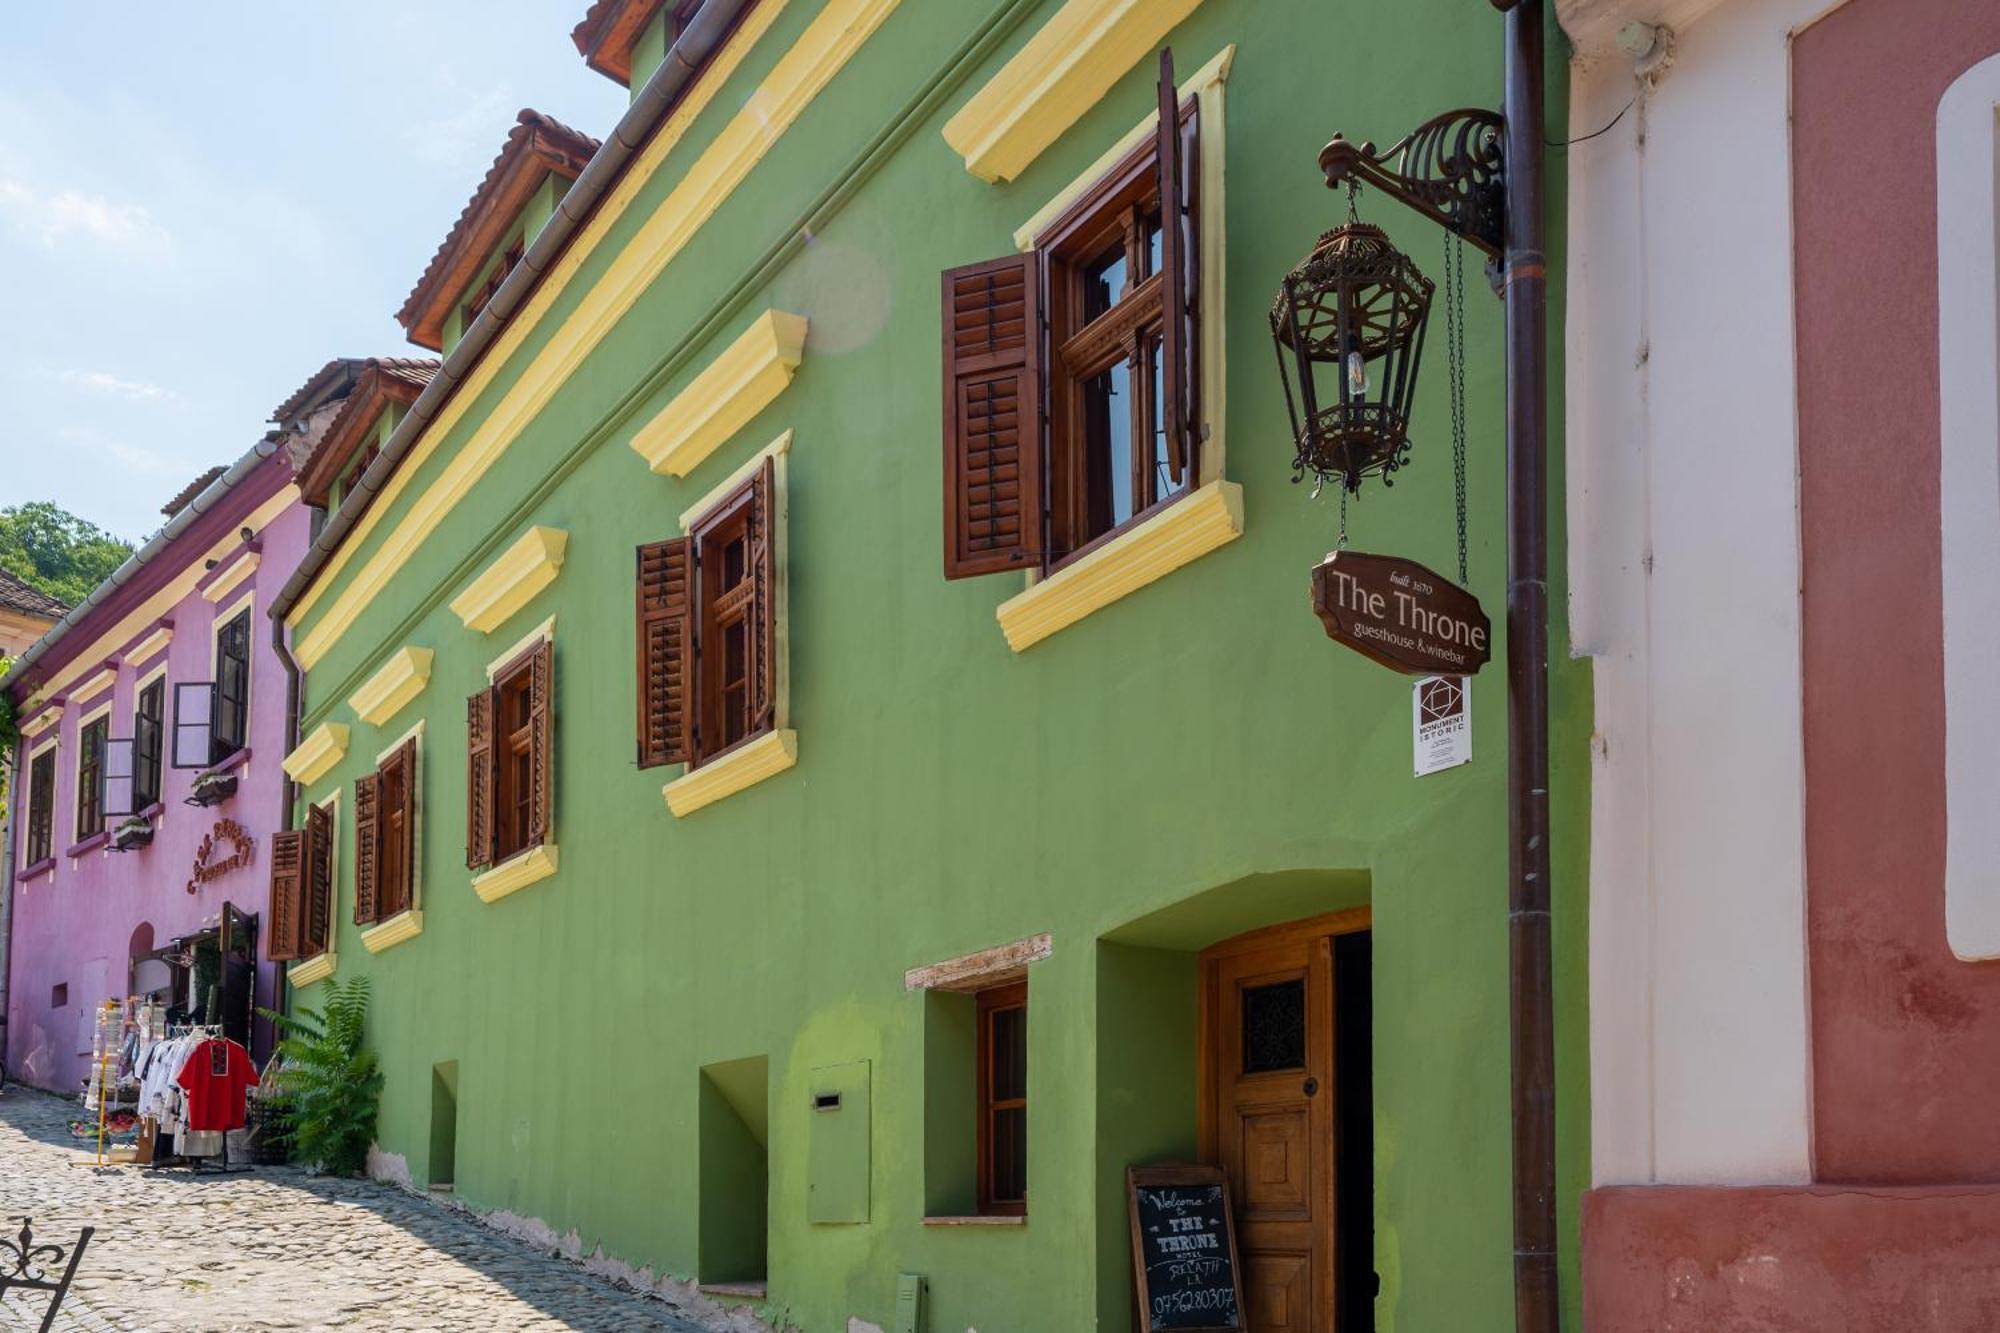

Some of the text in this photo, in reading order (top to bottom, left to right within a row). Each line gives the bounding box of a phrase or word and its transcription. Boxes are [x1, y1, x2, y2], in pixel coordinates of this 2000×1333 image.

[1333, 570, 1486, 651] The Throne
[1354, 623, 1415, 650] guesthouse
[1419, 714, 1465, 735] MONUMENT
[1419, 723, 1465, 743] ISTORIC
[1149, 1190, 1203, 1211] Welcome
[1168, 1216, 1204, 1233] THE
[1156, 1232, 1219, 1253] THRONE
